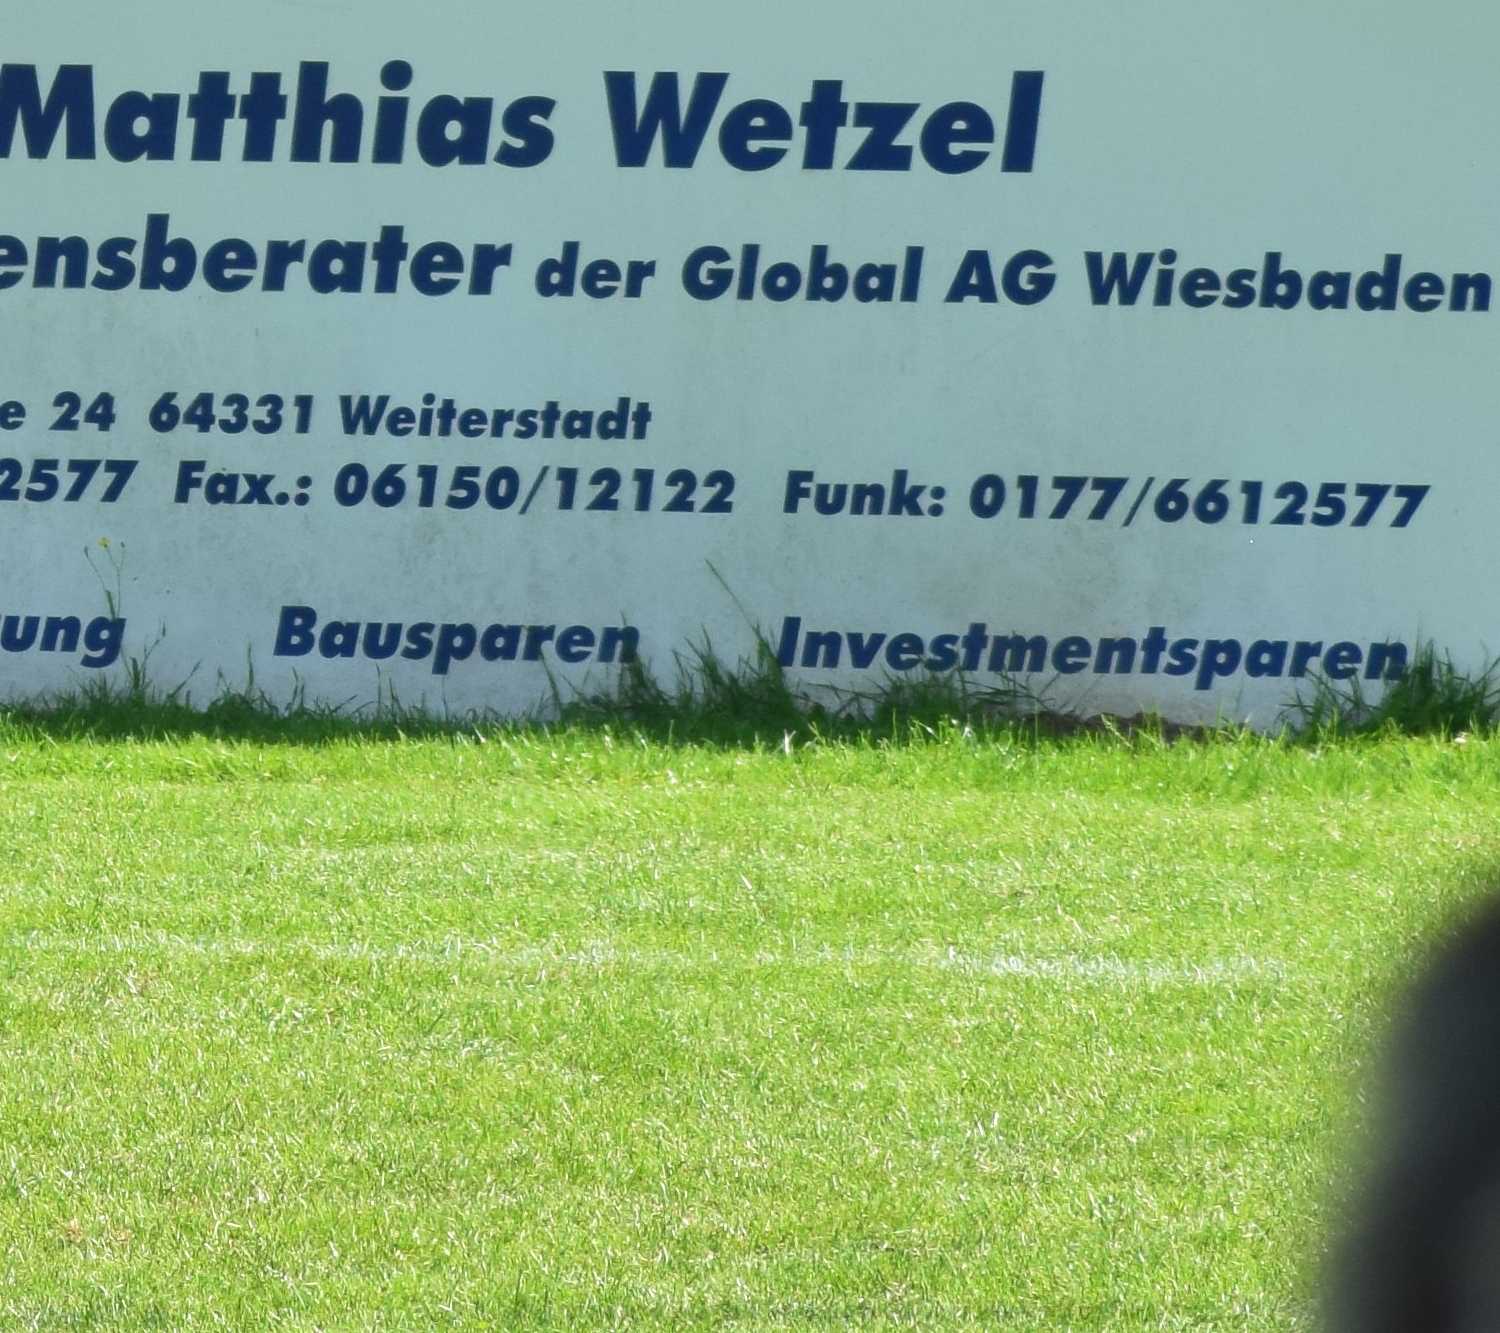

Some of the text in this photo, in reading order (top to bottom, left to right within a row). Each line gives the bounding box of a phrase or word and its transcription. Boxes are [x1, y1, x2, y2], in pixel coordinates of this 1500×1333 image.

[602, 69, 1045, 174] Wetzel
[533, 241, 656, 300] der
[680, 243, 925, 303] Global
[944, 248, 1057, 306] AG
[1083, 249, 1493, 314] Wiesbaden
[47, 390, 117, 432] 24
[147, 391, 313, 436] 64331
[338, 393, 652, 441] Weiterstadt
[174, 459, 311, 508] Fax.:
[333, 461, 736, 515] 06150/12122
[782, 469, 946, 518] Funk:
[968, 473, 1431, 529] 0177/6612577
[273, 605, 641, 674] Bausparen
[776, 616, 1410, 691] Investmentsparen
